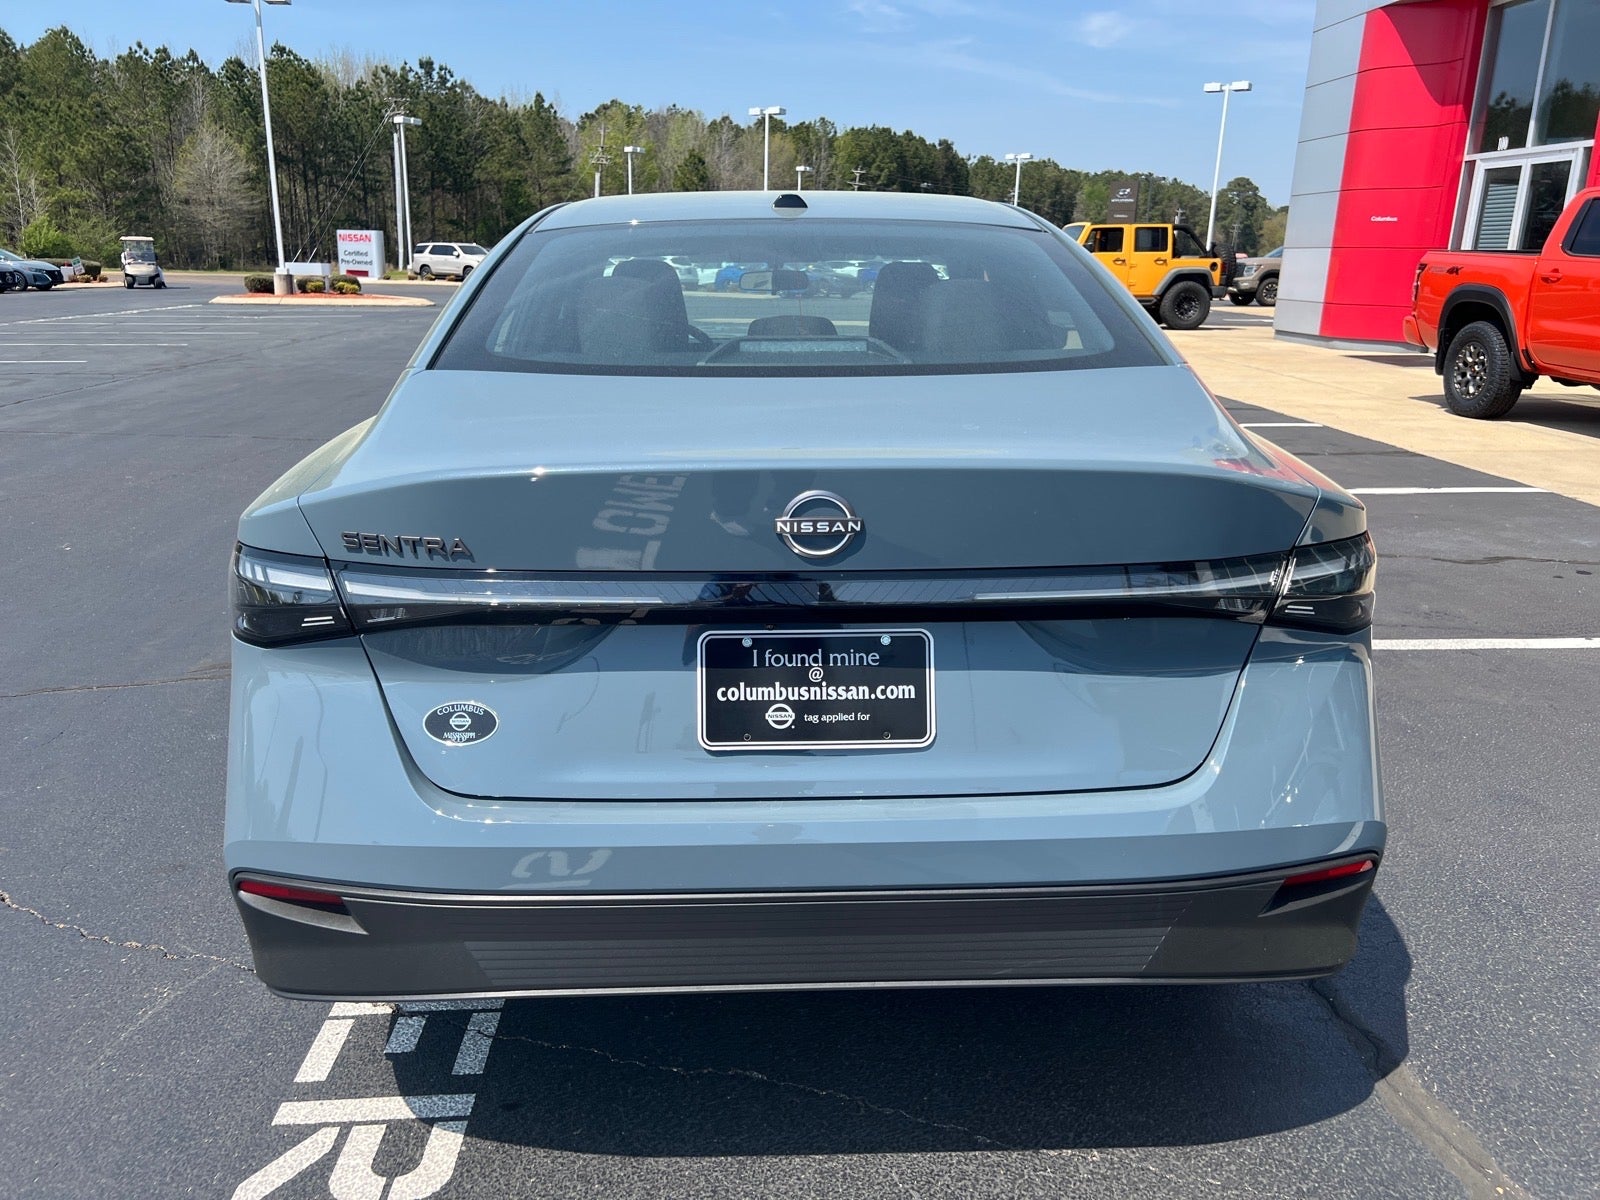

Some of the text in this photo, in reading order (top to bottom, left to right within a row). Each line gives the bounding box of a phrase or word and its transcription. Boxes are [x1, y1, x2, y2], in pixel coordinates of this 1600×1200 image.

[338, 233, 372, 242] NISSAN
[340, 258, 374, 266] Pre-Owned
[776, 520, 861, 533] NISSAN
[341, 531, 473, 560] SENTRA
[752, 648, 880, 667] I found mine
[808, 667, 824, 682] @
[716, 681, 916, 702] columbusnissan.com
[436, 704, 485, 716] COLUMBUS
[803, 711, 871, 724] tag applied for
